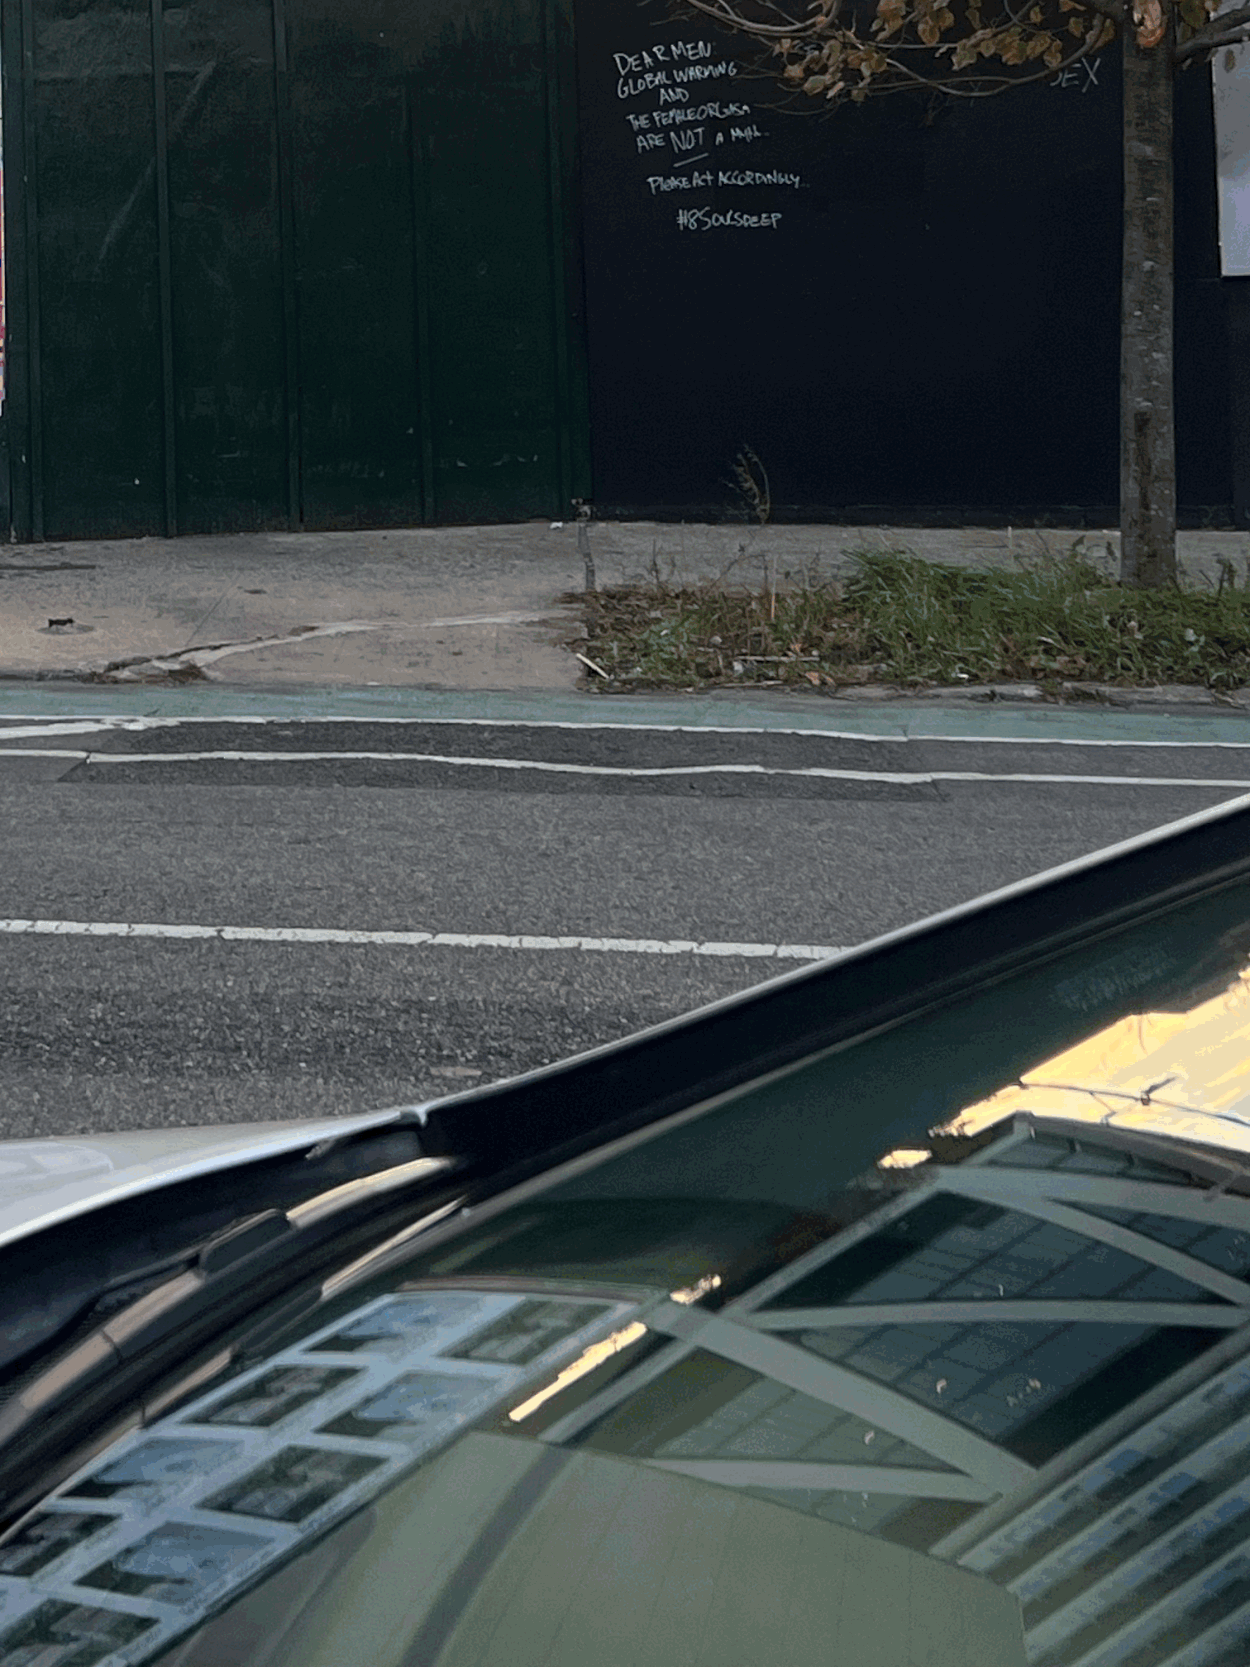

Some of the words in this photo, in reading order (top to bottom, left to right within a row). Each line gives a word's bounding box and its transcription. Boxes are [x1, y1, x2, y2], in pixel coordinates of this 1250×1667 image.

[613, 45, 671, 76] DEAR
[617, 72, 673, 99] GLOBAL
[673, 61, 738, 85] WARMING
[659, 88, 690, 106] AND
[626, 113, 652, 132] THE
[636, 135, 666, 154] ARE
[670, 127, 706, 154] NOT
[715, 132, 724, 146] A
